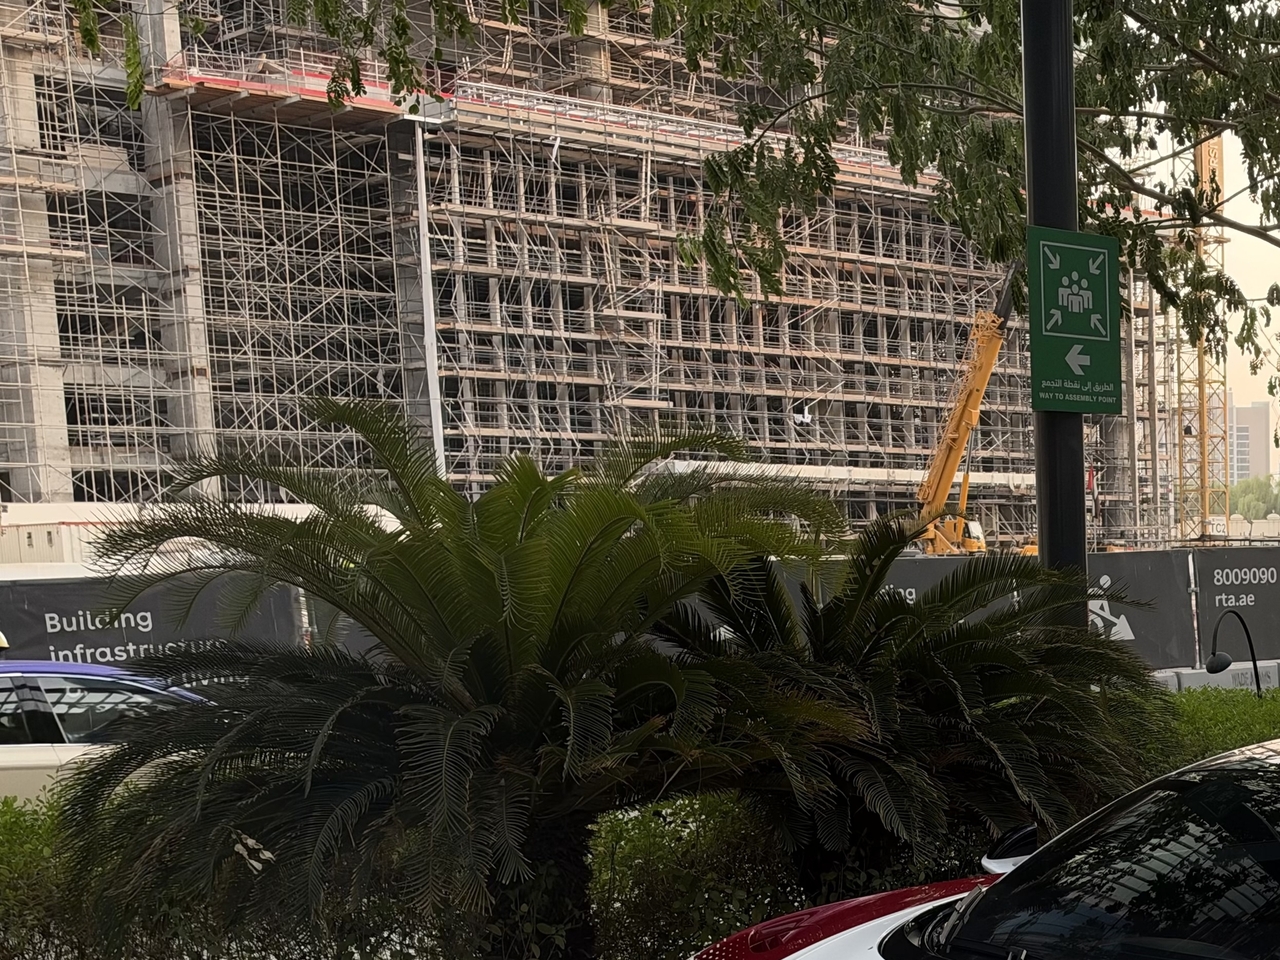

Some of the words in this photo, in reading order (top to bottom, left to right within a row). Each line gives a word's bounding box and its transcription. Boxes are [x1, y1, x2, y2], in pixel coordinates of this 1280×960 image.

[1041, 379, 1062, 389] التجمع
[1063, 379, 1080, 389] نقطة
[1081, 381, 1092, 393] إلى
[1093, 382, 1114, 393] الطريق
[1064, 394, 1097, 402] ASSEMBLY
[1211, 523, 1226, 534] TC2
[1213, 566, 1277, 586] 8009090
[1215, 592, 1255, 607] rta.ae
[44, 608, 153, 632] Building
